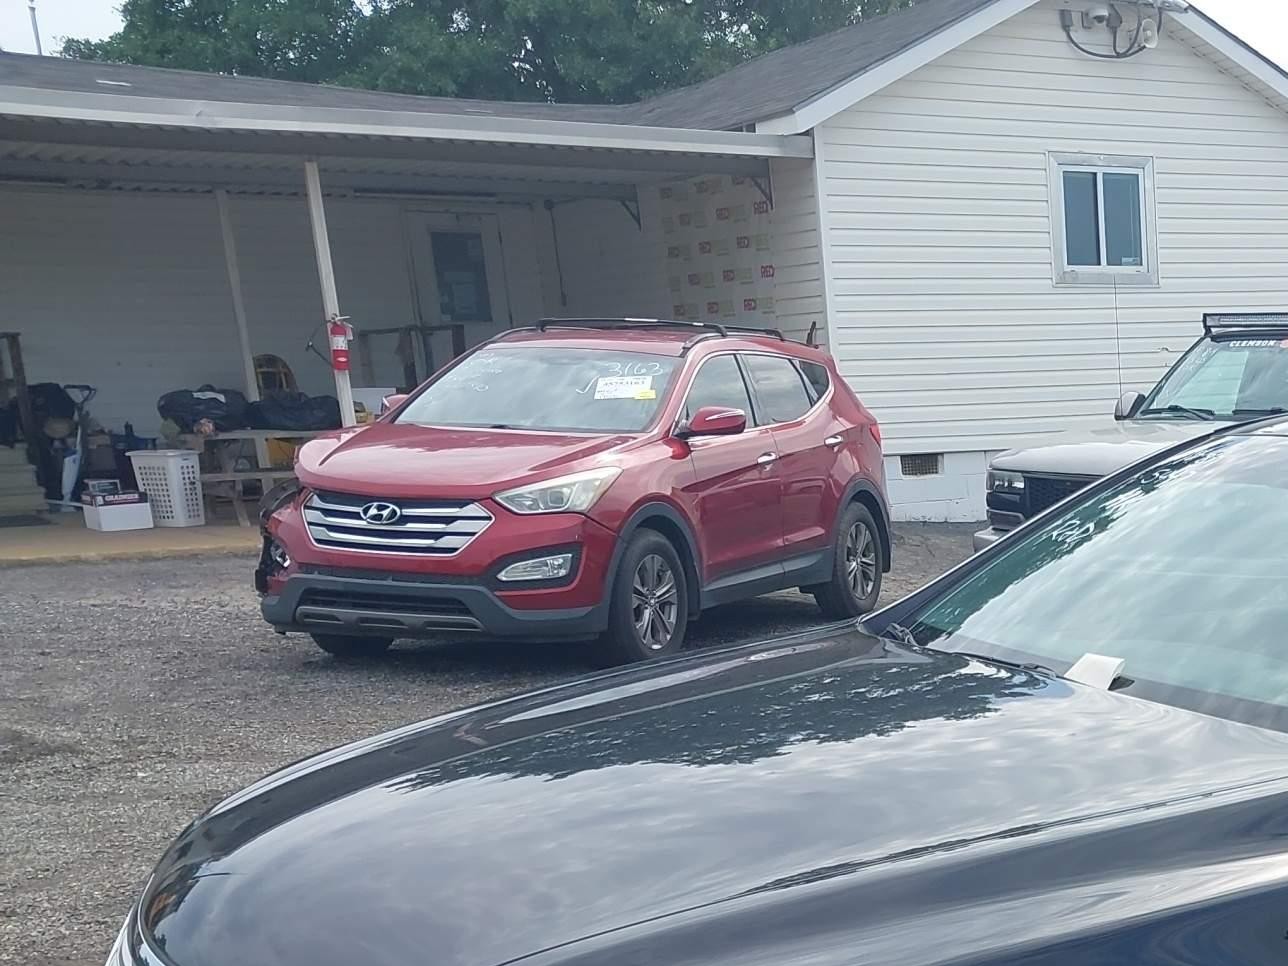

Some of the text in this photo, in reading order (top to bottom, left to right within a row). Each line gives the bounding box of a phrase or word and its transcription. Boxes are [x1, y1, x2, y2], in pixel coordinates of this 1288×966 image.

[754, 201, 769, 215] RED
[736, 236, 750, 248] RED
[761, 264, 775, 278] RED
[743, 298, 757, 311] RED
[1229, 339, 1276, 348] CLEMSON
[607, 361, 664, 376] 3163
